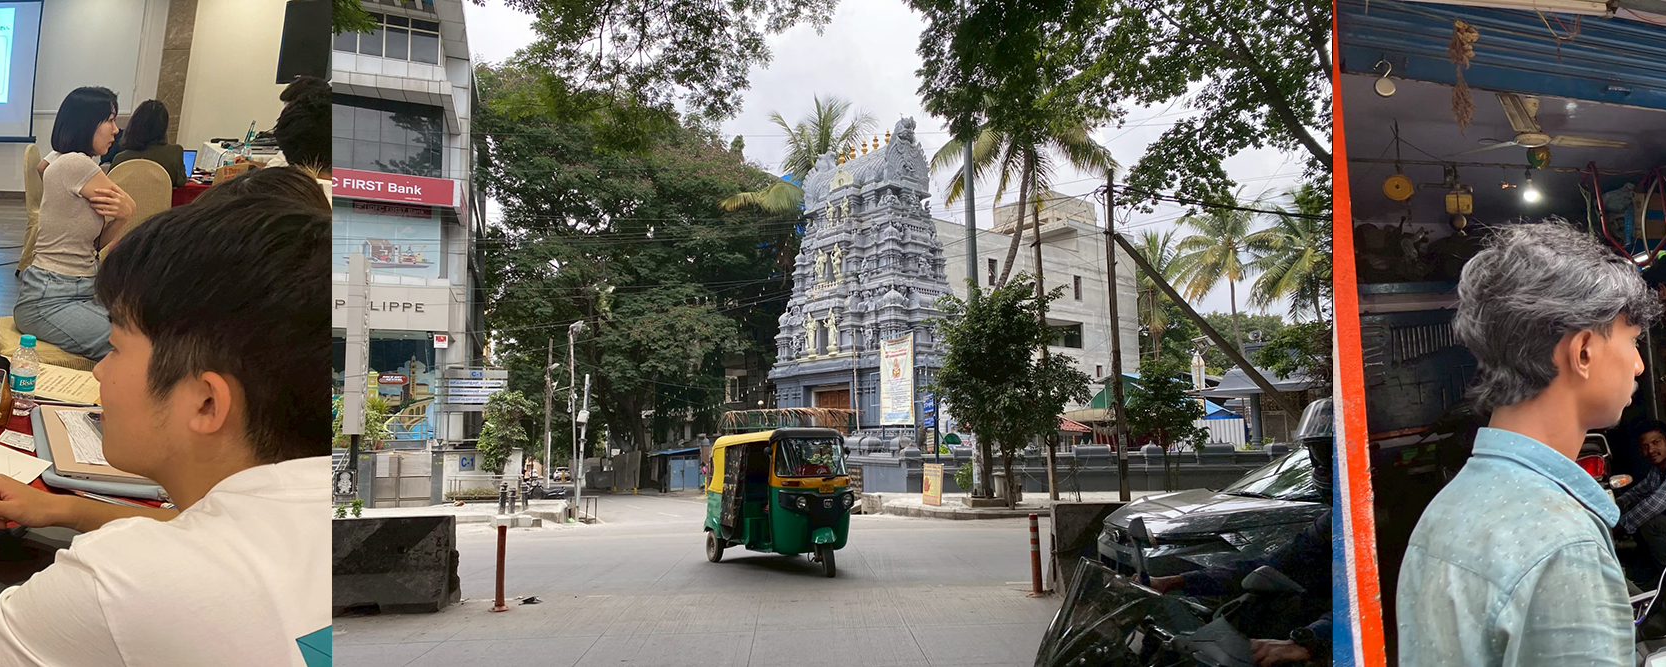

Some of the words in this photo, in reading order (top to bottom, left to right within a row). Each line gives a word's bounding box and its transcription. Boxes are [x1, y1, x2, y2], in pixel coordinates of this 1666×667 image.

[343, 178, 384, 192] FIRST
[388, 182, 422, 195] Bank
[335, 299, 425, 313] PLIPPE
[460, 457, 474, 468] C-1
